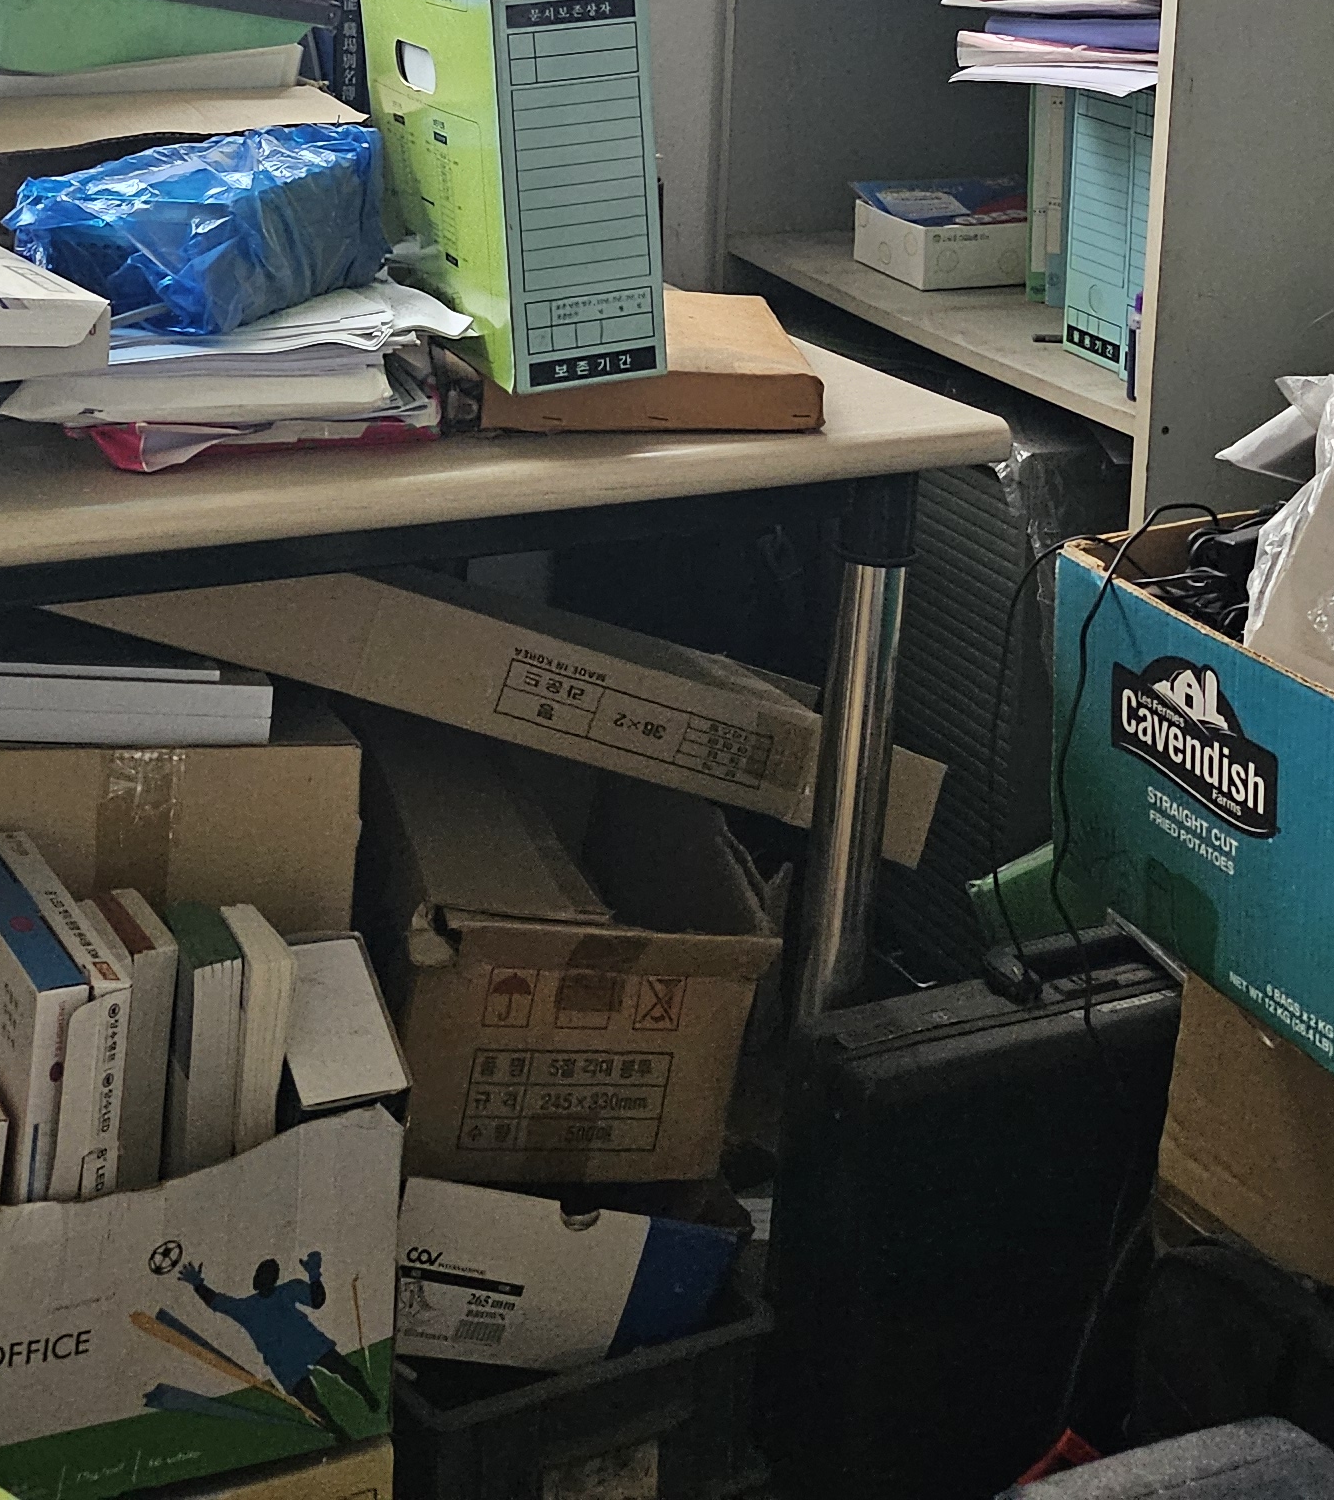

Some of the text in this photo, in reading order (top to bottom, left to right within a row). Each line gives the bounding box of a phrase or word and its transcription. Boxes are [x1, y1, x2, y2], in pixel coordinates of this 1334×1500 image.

[528, 0, 613, 23] 문서보존상자
[1137, 690, 1186, 728] Les Fermes
[1121, 688, 1265, 815] Cavendish
[1146, 785, 1239, 857] STRAIGHT CUT
[1211, 787, 1242, 816] Farms
[1149, 809, 1235, 875] FRIED POTATOES
[1229, 970, 1248, 993] NET
[1248, 985, 1263, 1004] WT
[1276, 1006, 1291, 1024] KG
[1273, 989, 1301, 1017] BAGS
[1317, 1019, 1334, 1039] KG
